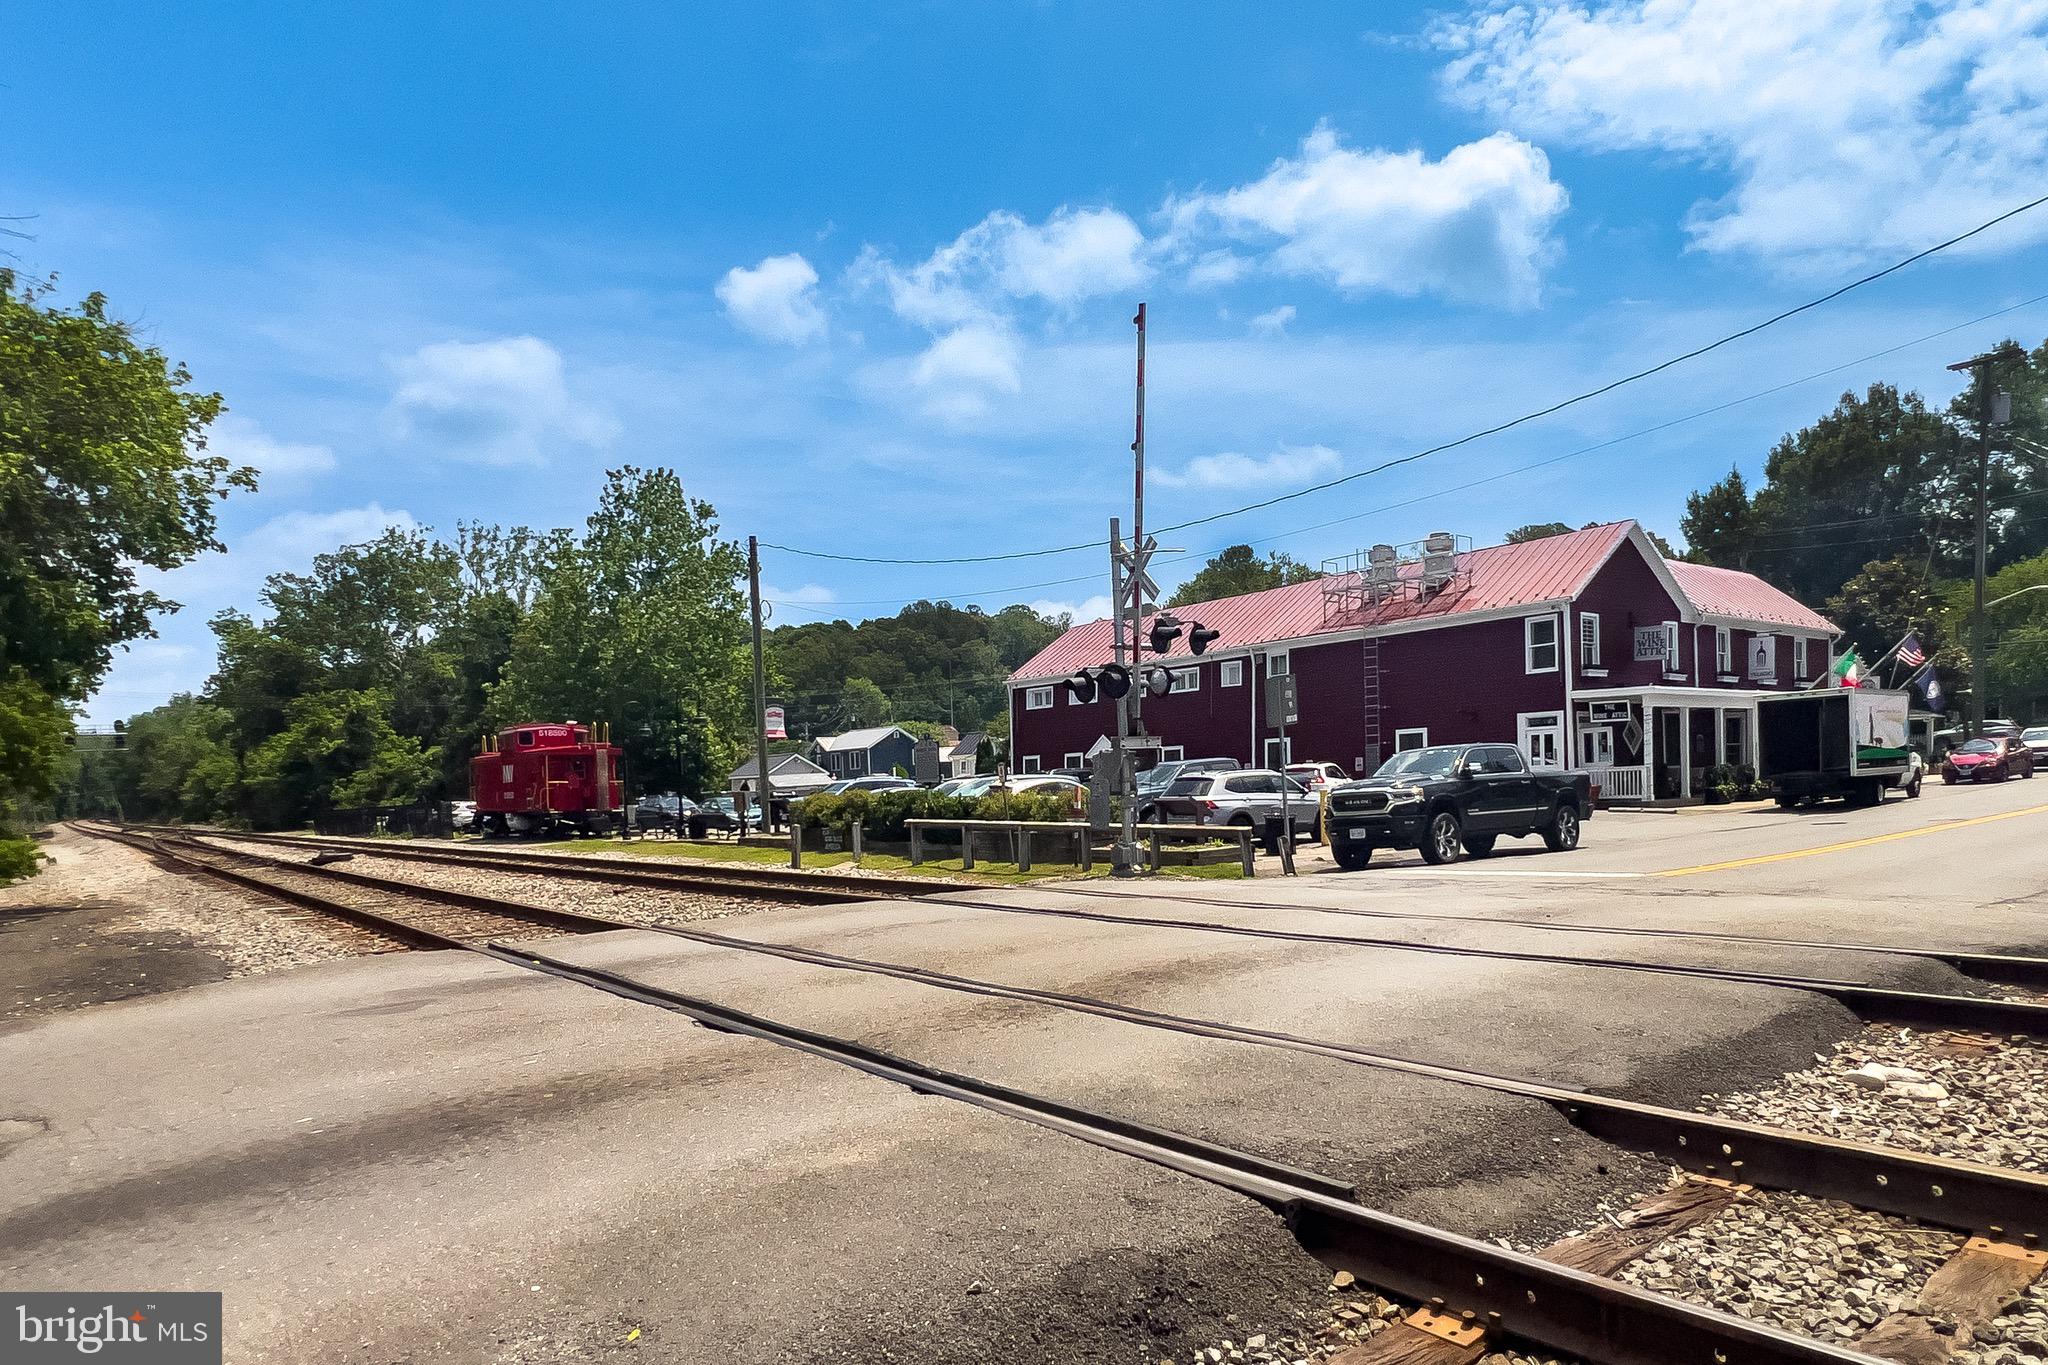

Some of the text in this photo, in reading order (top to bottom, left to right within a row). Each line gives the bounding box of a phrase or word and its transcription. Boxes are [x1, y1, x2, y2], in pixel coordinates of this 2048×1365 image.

[1640, 630, 1661, 639] THE
[1637, 638, 1665, 648] WINE
[1636, 647, 1667, 656] ATTIC
